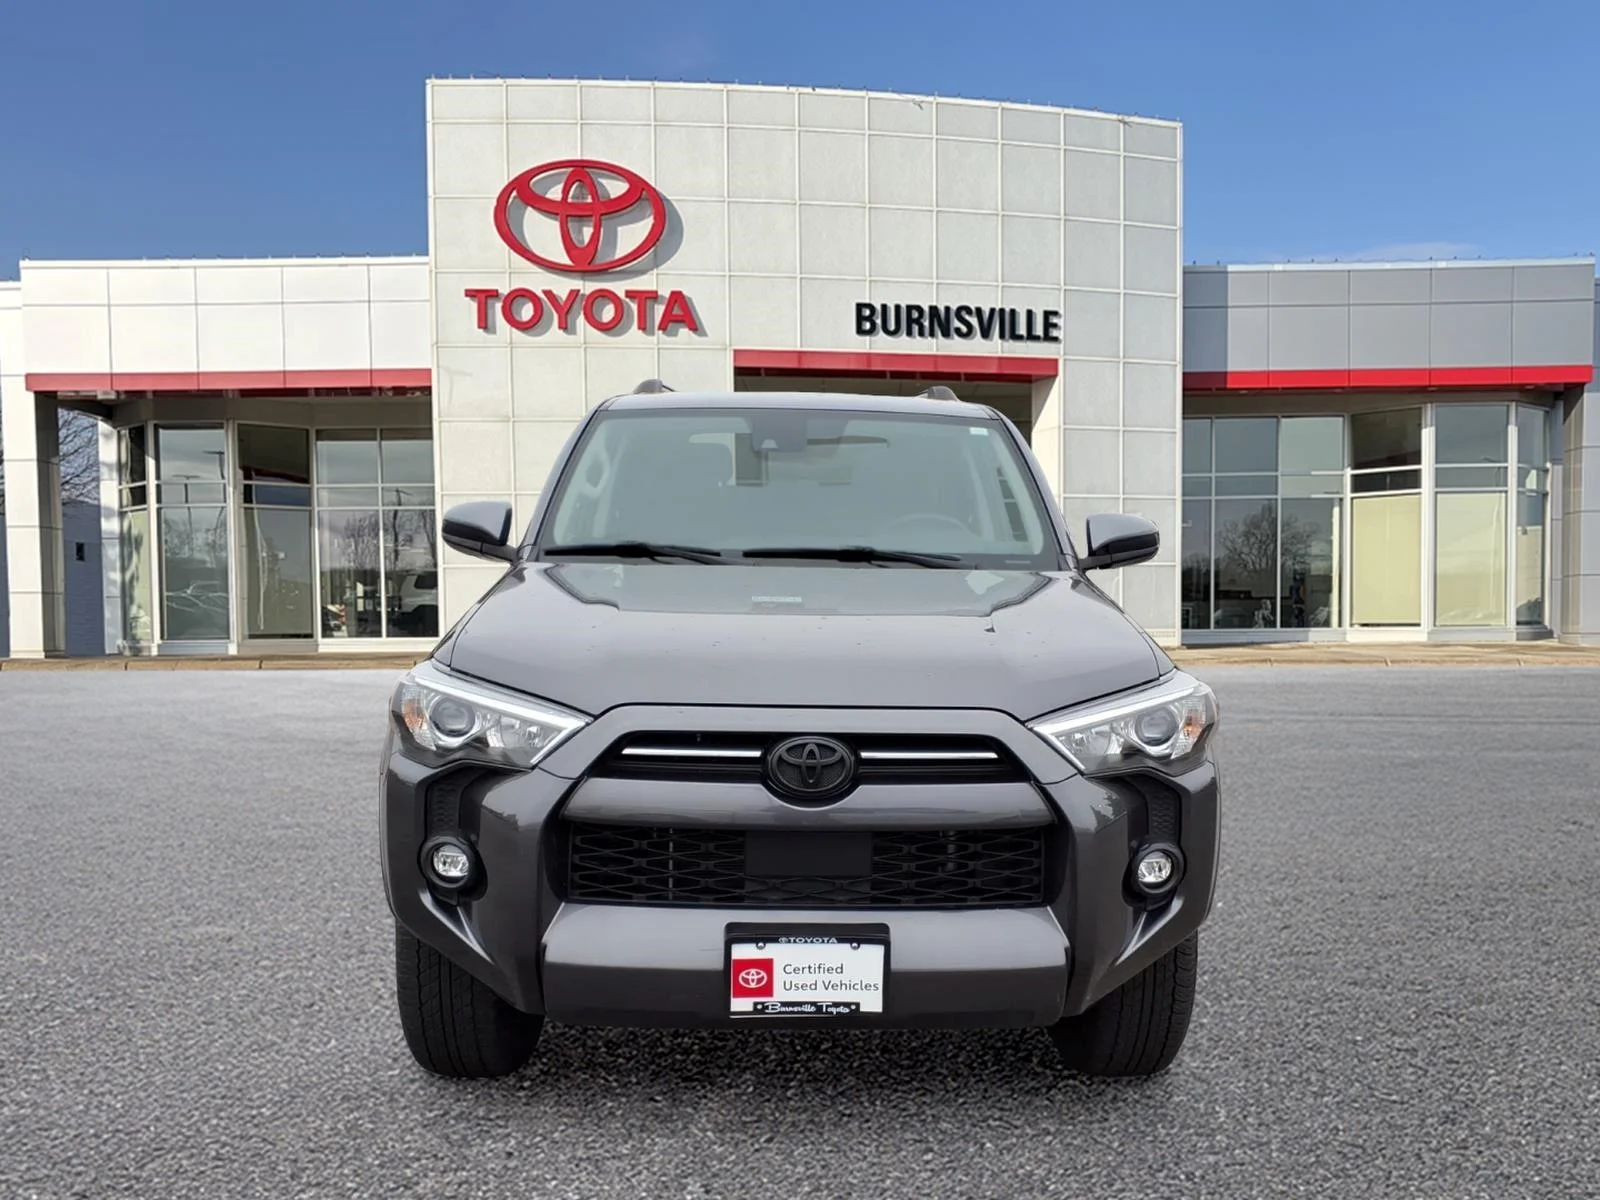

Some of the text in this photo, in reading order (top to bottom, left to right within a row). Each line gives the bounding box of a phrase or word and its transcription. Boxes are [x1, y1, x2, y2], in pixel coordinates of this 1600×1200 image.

[464, 288, 699, 332] TOYOTA
[855, 302, 1061, 342] BURNSVILLE
[783, 963, 844, 975] Certified
[783, 980, 880, 991] Used Vehicles
[817, 1002, 850, 1015] Toyota
